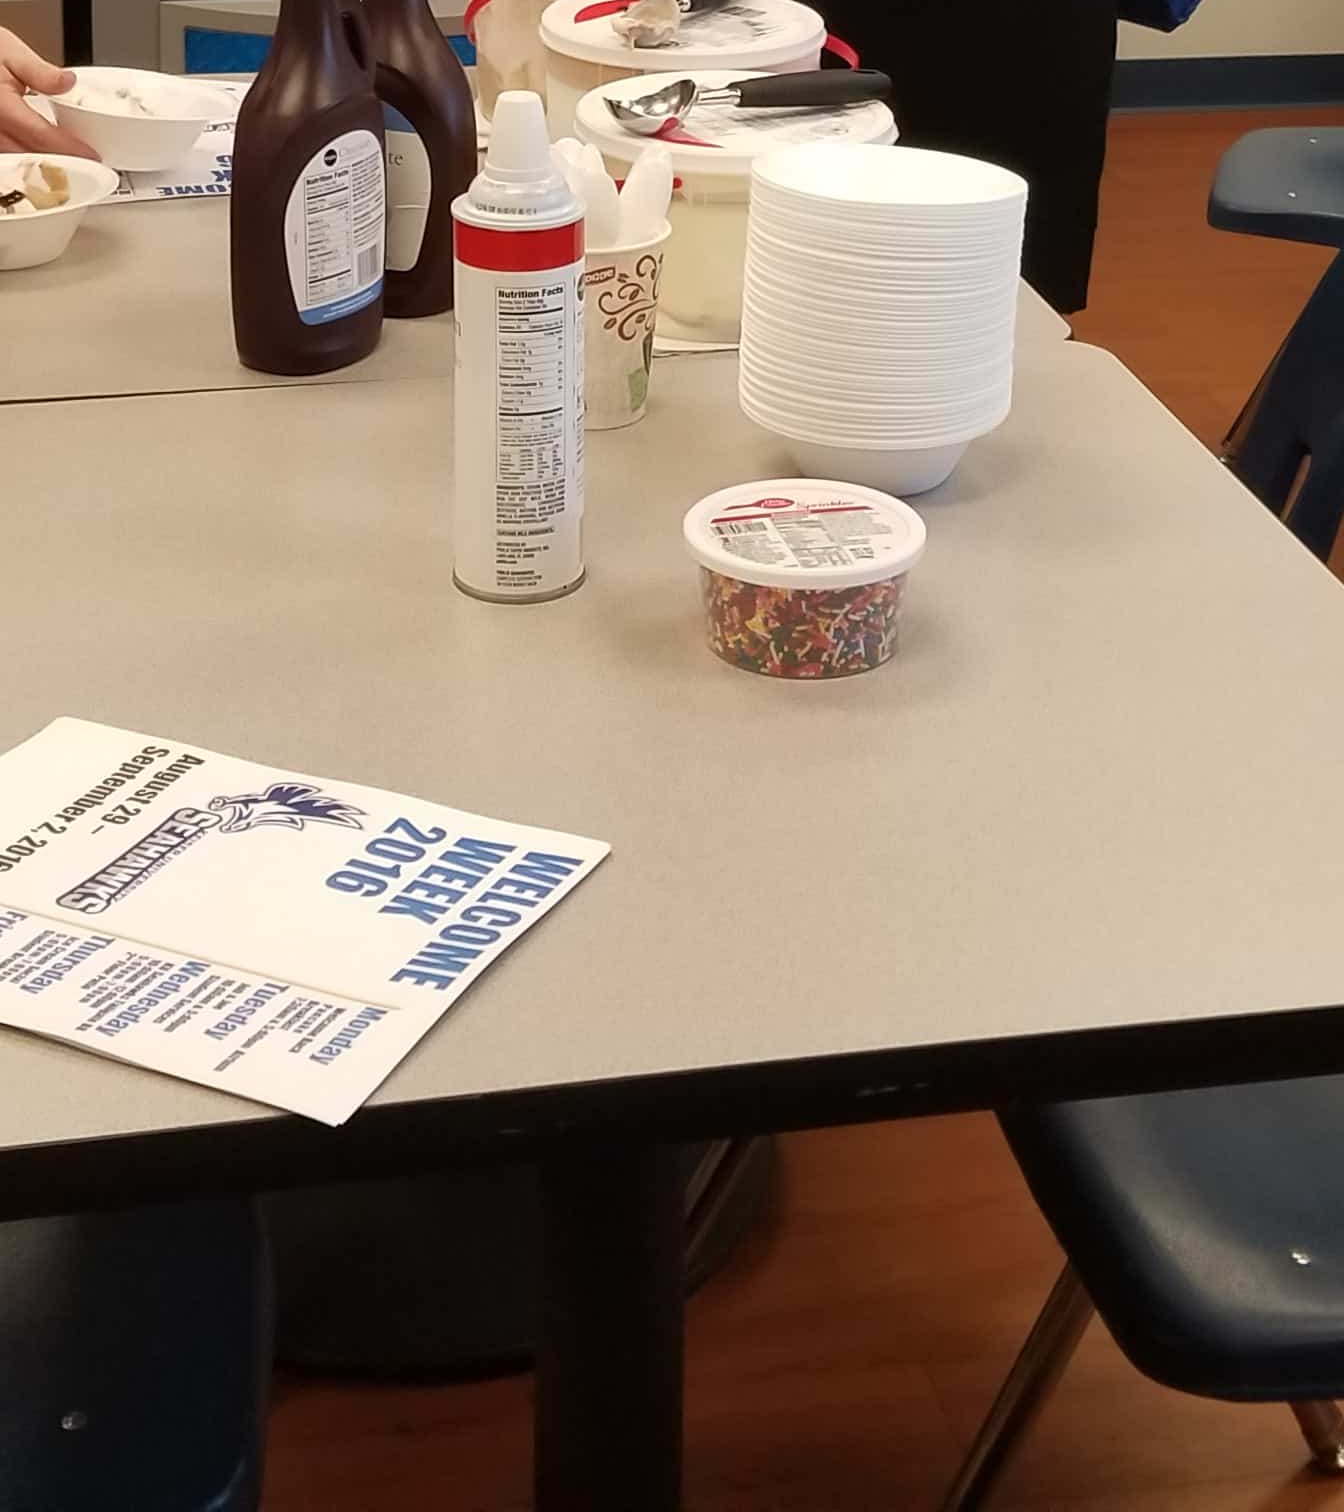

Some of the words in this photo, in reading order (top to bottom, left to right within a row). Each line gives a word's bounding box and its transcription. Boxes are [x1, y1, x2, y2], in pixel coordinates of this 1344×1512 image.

[498, 289, 539, 299] Nutrition
[542, 287, 564, 298] Facts
[55, 746, 170, 822] September
[126, 754, 205, 804] August
[31, 822, 67, 834] 2,
[101, 805, 141, 824] 29
[55, 807, 222, 914] SEAHAWKS
[326, 818, 447, 897] 2016
[378, 837, 517, 924] WEEK
[389, 852, 584, 990] WELCOME
[20, 936, 116, 994] Thursday
[96, 961, 211, 1037] Wednesday
[204, 983, 290, 1040] Tuesday
[309, 1007, 388, 1065] Monday
